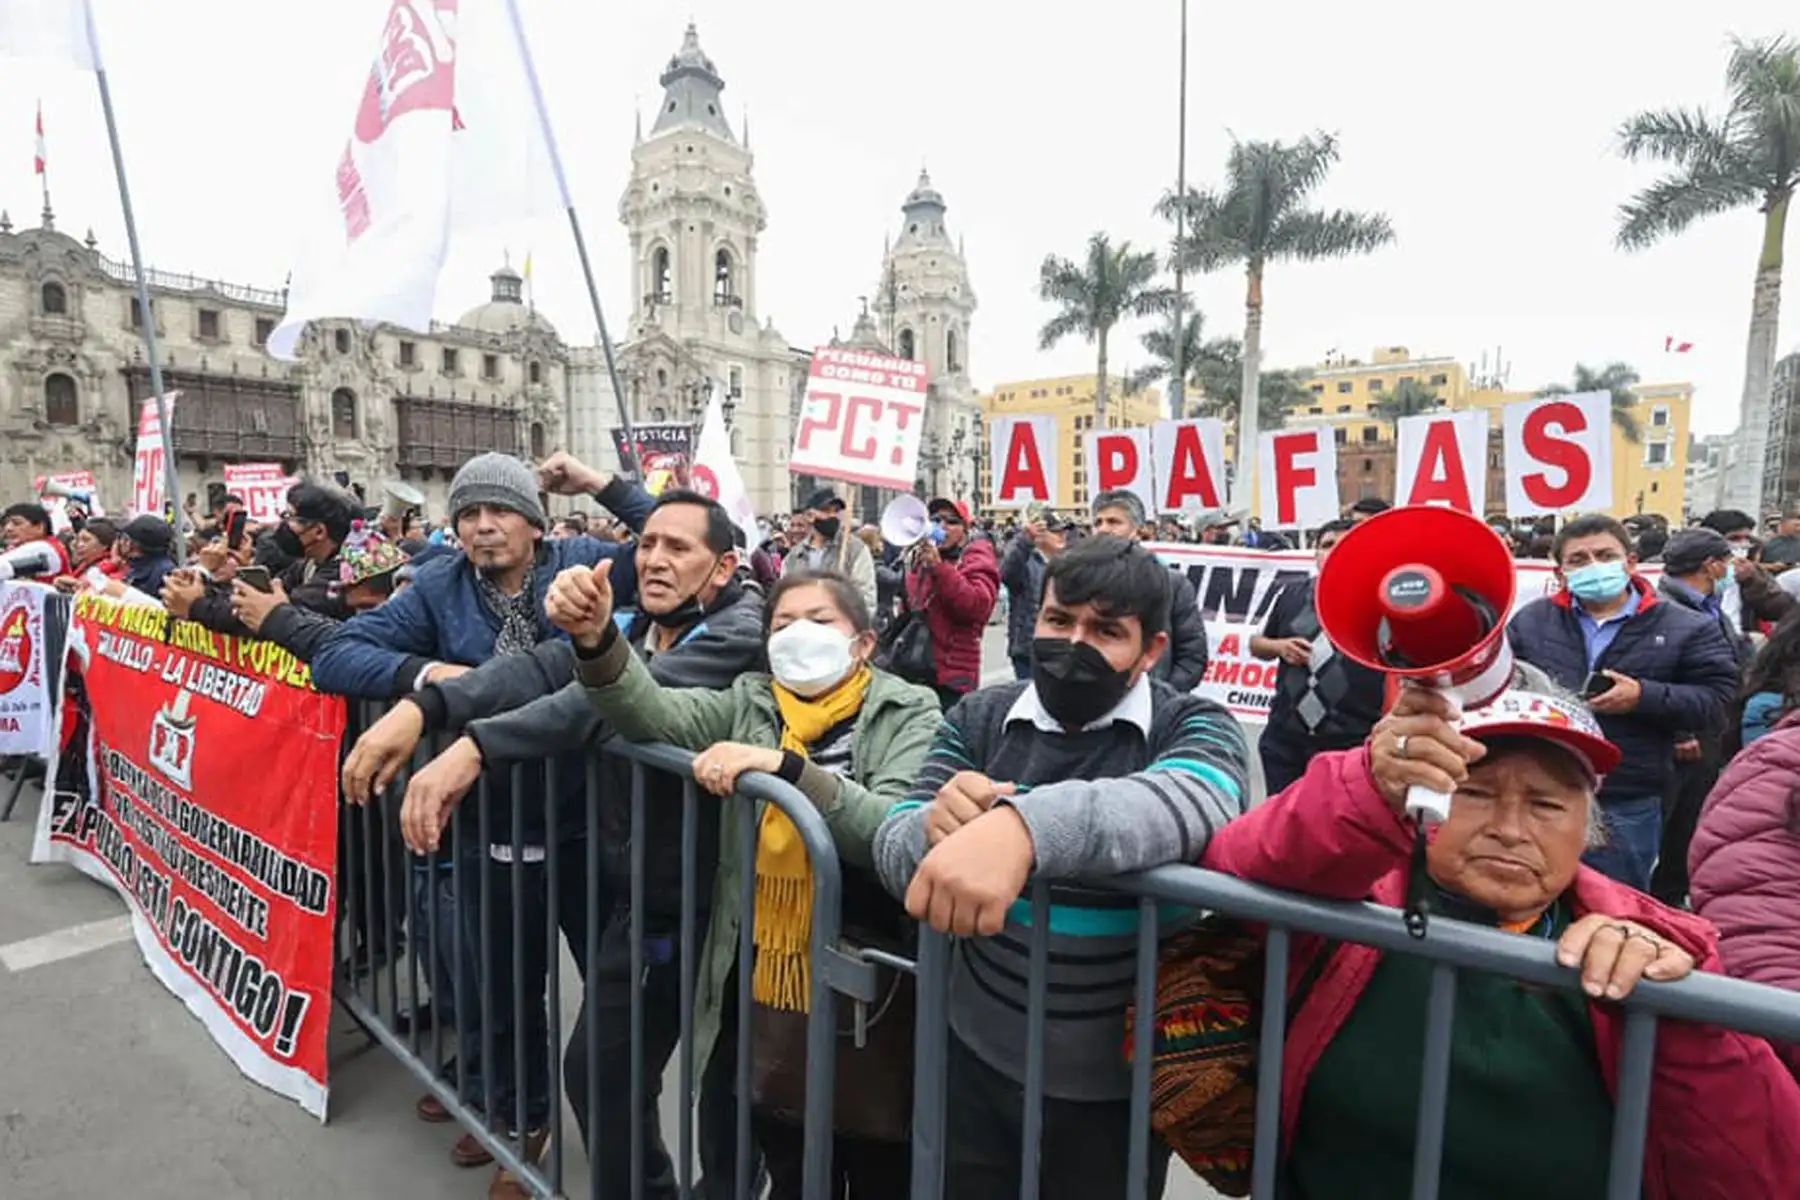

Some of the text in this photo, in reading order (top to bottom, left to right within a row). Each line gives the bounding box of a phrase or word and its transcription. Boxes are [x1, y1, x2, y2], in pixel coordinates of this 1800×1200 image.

[821, 365, 884, 384] COMO
[160, 652, 186, 685] LA
[186, 661, 266, 718] LIBERTAD
[179, 801, 329, 912] GOBERNABILIDAD
